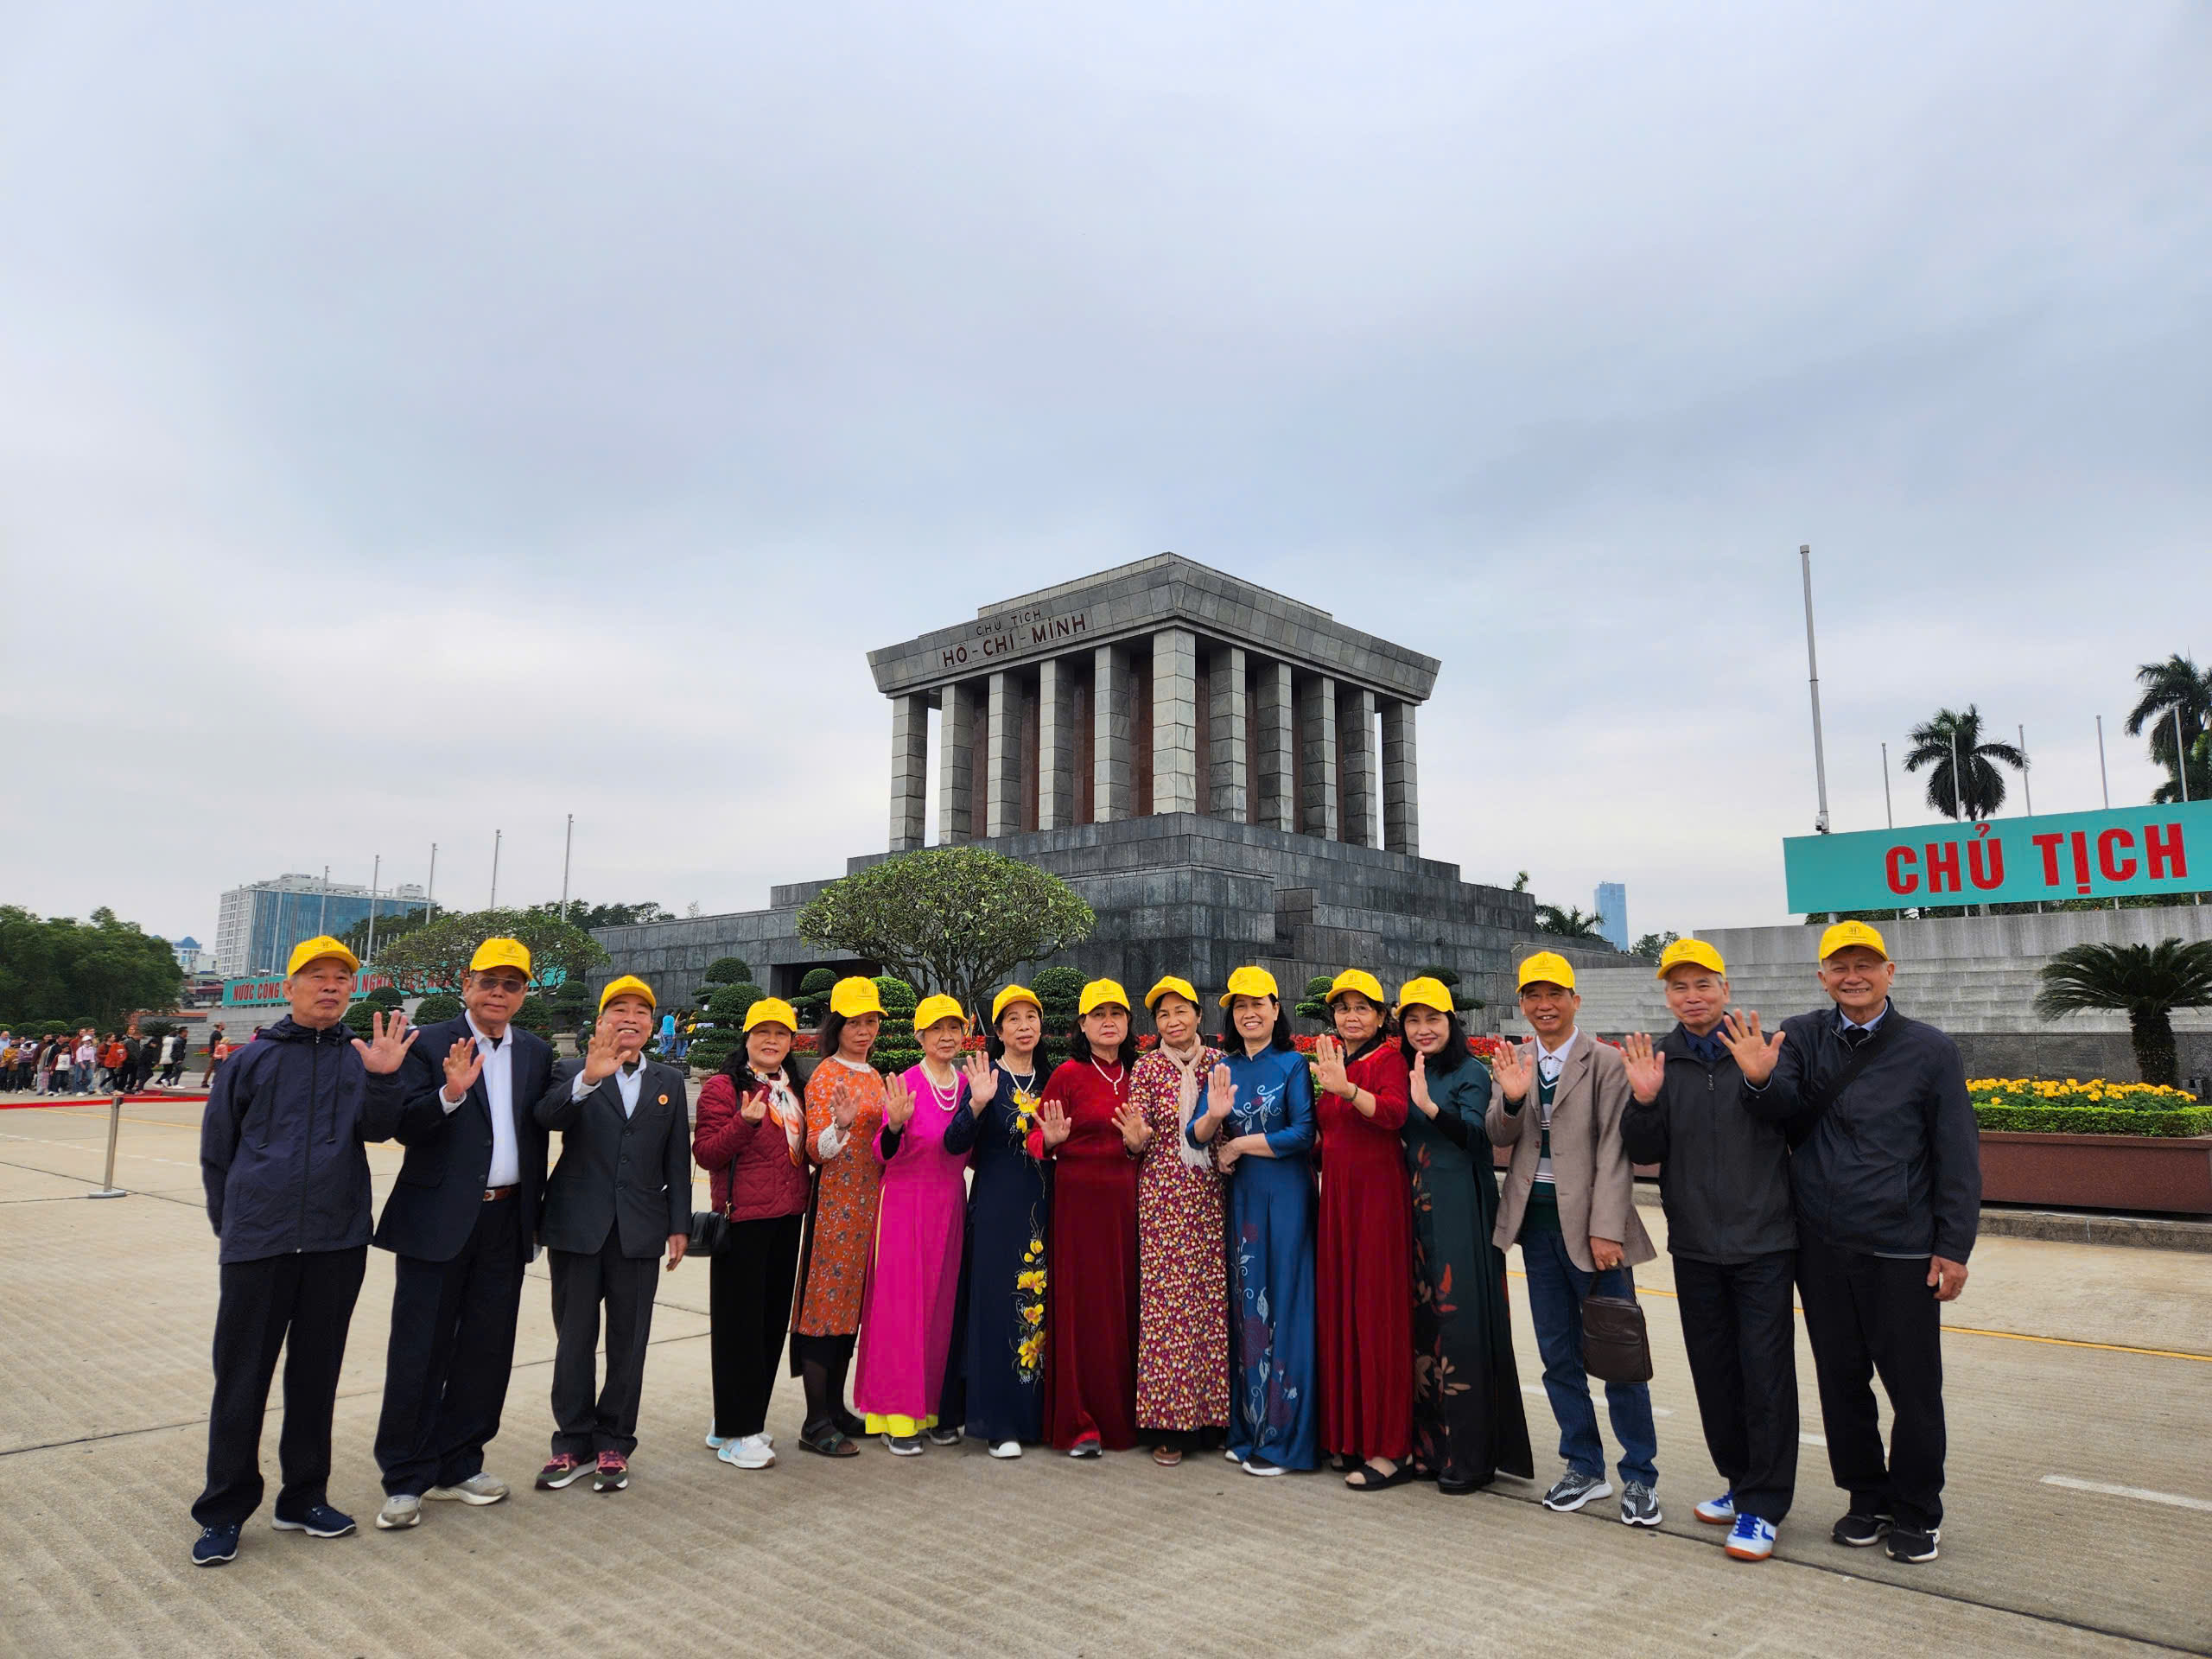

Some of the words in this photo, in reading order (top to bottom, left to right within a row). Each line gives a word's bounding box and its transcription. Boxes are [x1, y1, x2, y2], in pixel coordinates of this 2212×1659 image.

[1885, 823, 2005, 895] CHỦ
[2032, 823, 2188, 894] TỊCH
[233, 982, 255, 1001] NƯỚC
[257, 979, 280, 1002] CỘNG
